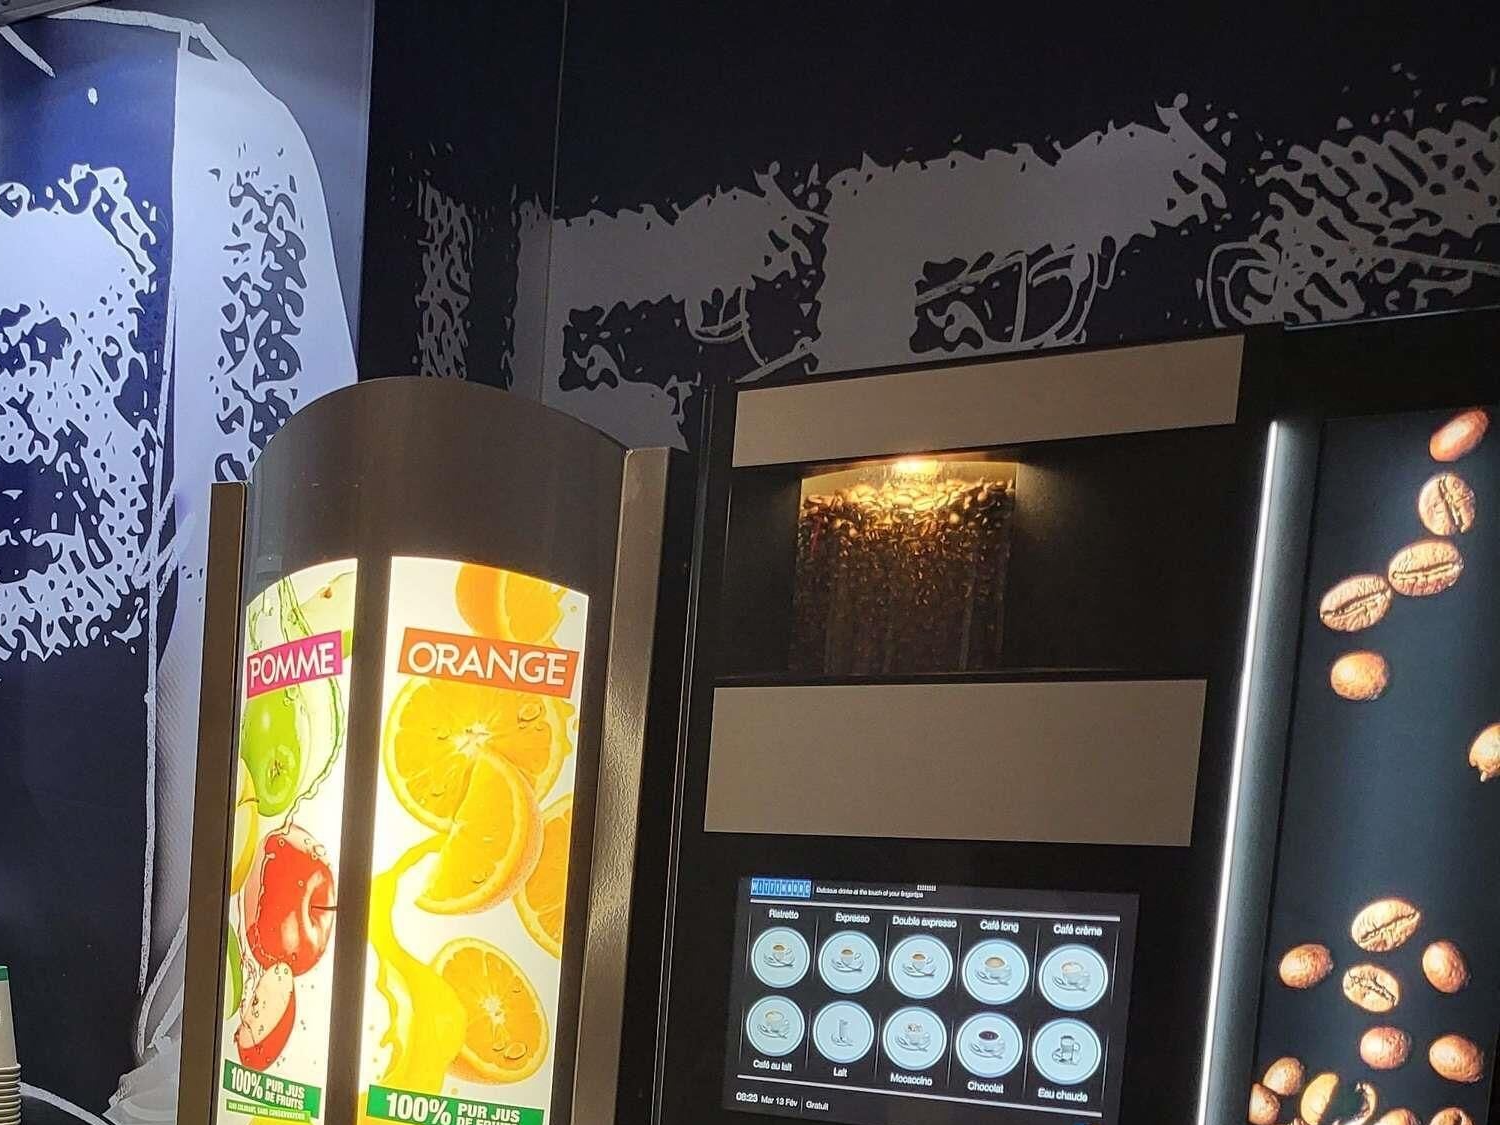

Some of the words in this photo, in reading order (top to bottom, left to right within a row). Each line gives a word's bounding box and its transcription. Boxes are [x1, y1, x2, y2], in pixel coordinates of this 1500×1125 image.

[250, 642, 334, 688] POMME
[408, 642, 568, 685] ORANGE
[893, 915, 919, 927] Double
[1000, 922, 1019, 934] long
[833, 1067, 848, 1077] Lait
[231, 1066, 263, 1099] 100%
[265, 1078, 284, 1094] PUR
[285, 1084, 305, 1099] JUS
[967, 1081, 1004, 1094] Chocolat
[265, 1091, 275, 1103] DE
[276, 1094, 304, 1110] FRUITS
[761, 1095, 774, 1104] Mar
[1038, 1088, 1055, 1099] Eau
[1056, 1089, 1088, 1102] chaude
[387, 1092, 451, 1125] 100%
[457, 1102, 487, 1119] PUR
[491, 1108, 520, 1123] JUS
[806, 1101, 829, 1111] Gratuit
